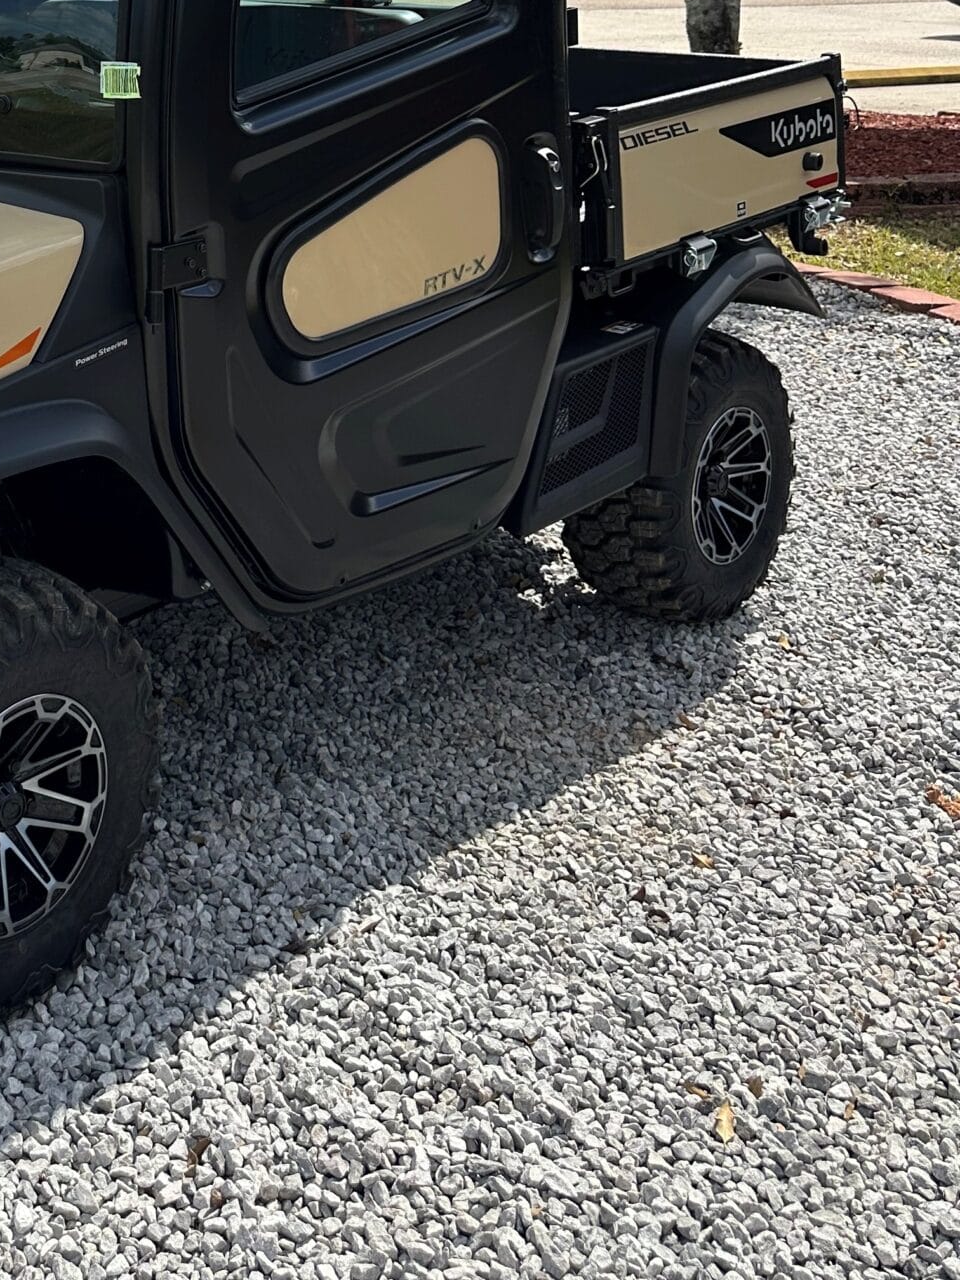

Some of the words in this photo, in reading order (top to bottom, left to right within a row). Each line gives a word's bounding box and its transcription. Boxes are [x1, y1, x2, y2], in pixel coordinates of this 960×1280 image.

[620, 121, 699, 151] DIESEL
[771, 108, 834, 148] Kubota
[424, 254, 486, 296] RTV-X
[75, 352, 98, 367] Power
[98, 338, 128, 356] Steering
